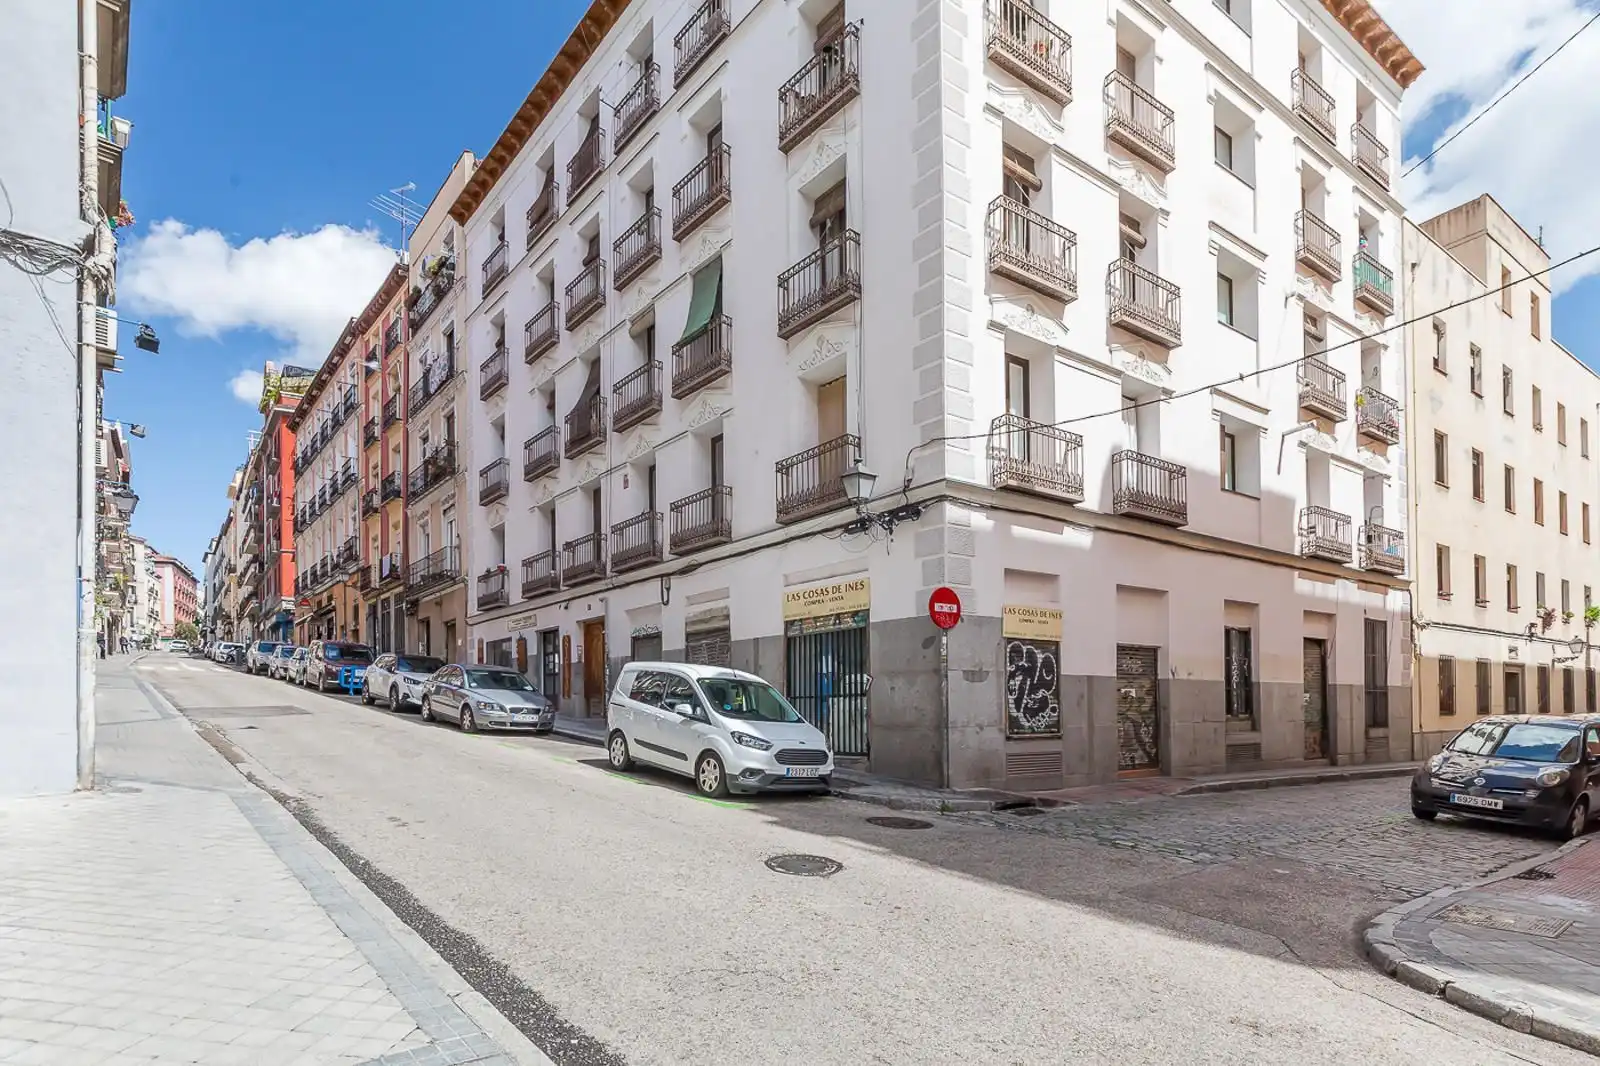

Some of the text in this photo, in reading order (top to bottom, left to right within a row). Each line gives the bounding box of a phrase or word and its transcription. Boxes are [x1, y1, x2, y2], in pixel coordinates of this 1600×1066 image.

[786, 580, 865, 603] LAS COSAS DE INES
[804, 598, 825, 607] COMPRA
[1004, 607, 1063, 620] LAS COSAS DE INES
[1456, 795, 1479, 805] 6975
